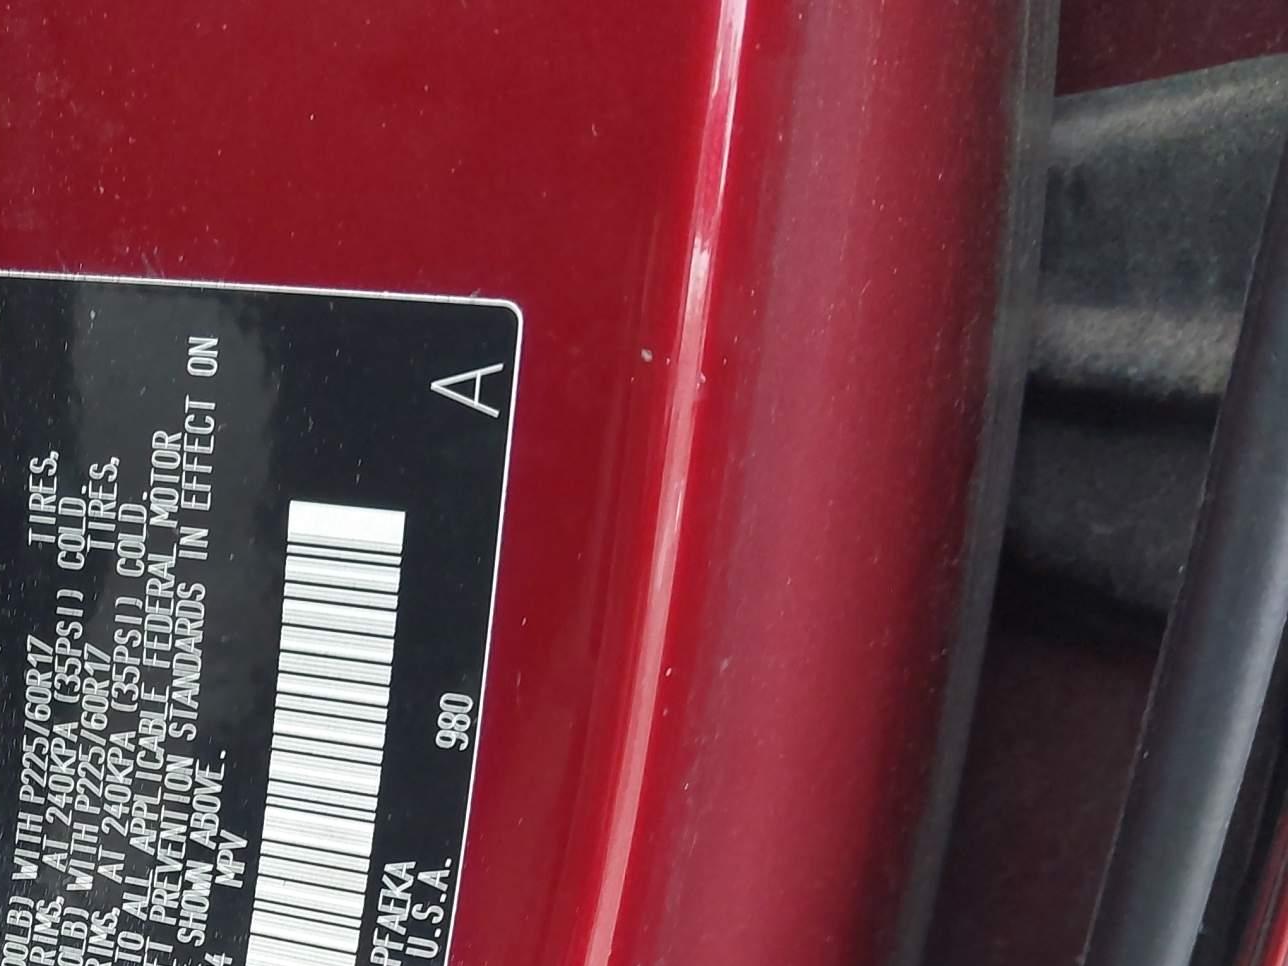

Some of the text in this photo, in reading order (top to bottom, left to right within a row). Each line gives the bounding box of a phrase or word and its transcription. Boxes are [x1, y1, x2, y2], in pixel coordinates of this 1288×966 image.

[186, 336, 219, 377] ON
[430, 363, 504, 418] A
[28, 450, 59, 545] TIRES,
[149, 430, 182, 529] MOTOR
[180, 394, 216, 511] EFFECT
[57, 485, 87, 569] COLD.
[87, 457, 120, 552] TIRES,
[116, 491, 148, 577] COLD.
[178, 526, 209, 560] IN
[53, 589, 83, 703] (35PSI)
[142, 543, 177, 668] FEDERAL
[111, 596, 143, 712] (35PSI)
[168, 582, 206, 741] STANDARDS
[19, 635, 53, 804] P225/60R17
[75, 642, 111, 814] P225/60R17
[435, 693, 474, 751] 980
[45, 721, 79, 826] 240KPA
[102, 731, 137, 836] 240KPA
[129, 681, 170, 855] APPLICABLE
[189, 750, 226, 850] ABOVE.
[11, 811, 43, 880] WITH
[42, 834, 70, 872] AT
[66, 823, 99, 891] WITH
[97, 844, 126, 884] AT
[149, 754, 195, 926] PREVENTION
[214, 829, 248, 888] MPV
[122, 868, 154, 921] ALL
[176, 859, 214, 947] SHOWN
[114, 931, 144, 963] TO
